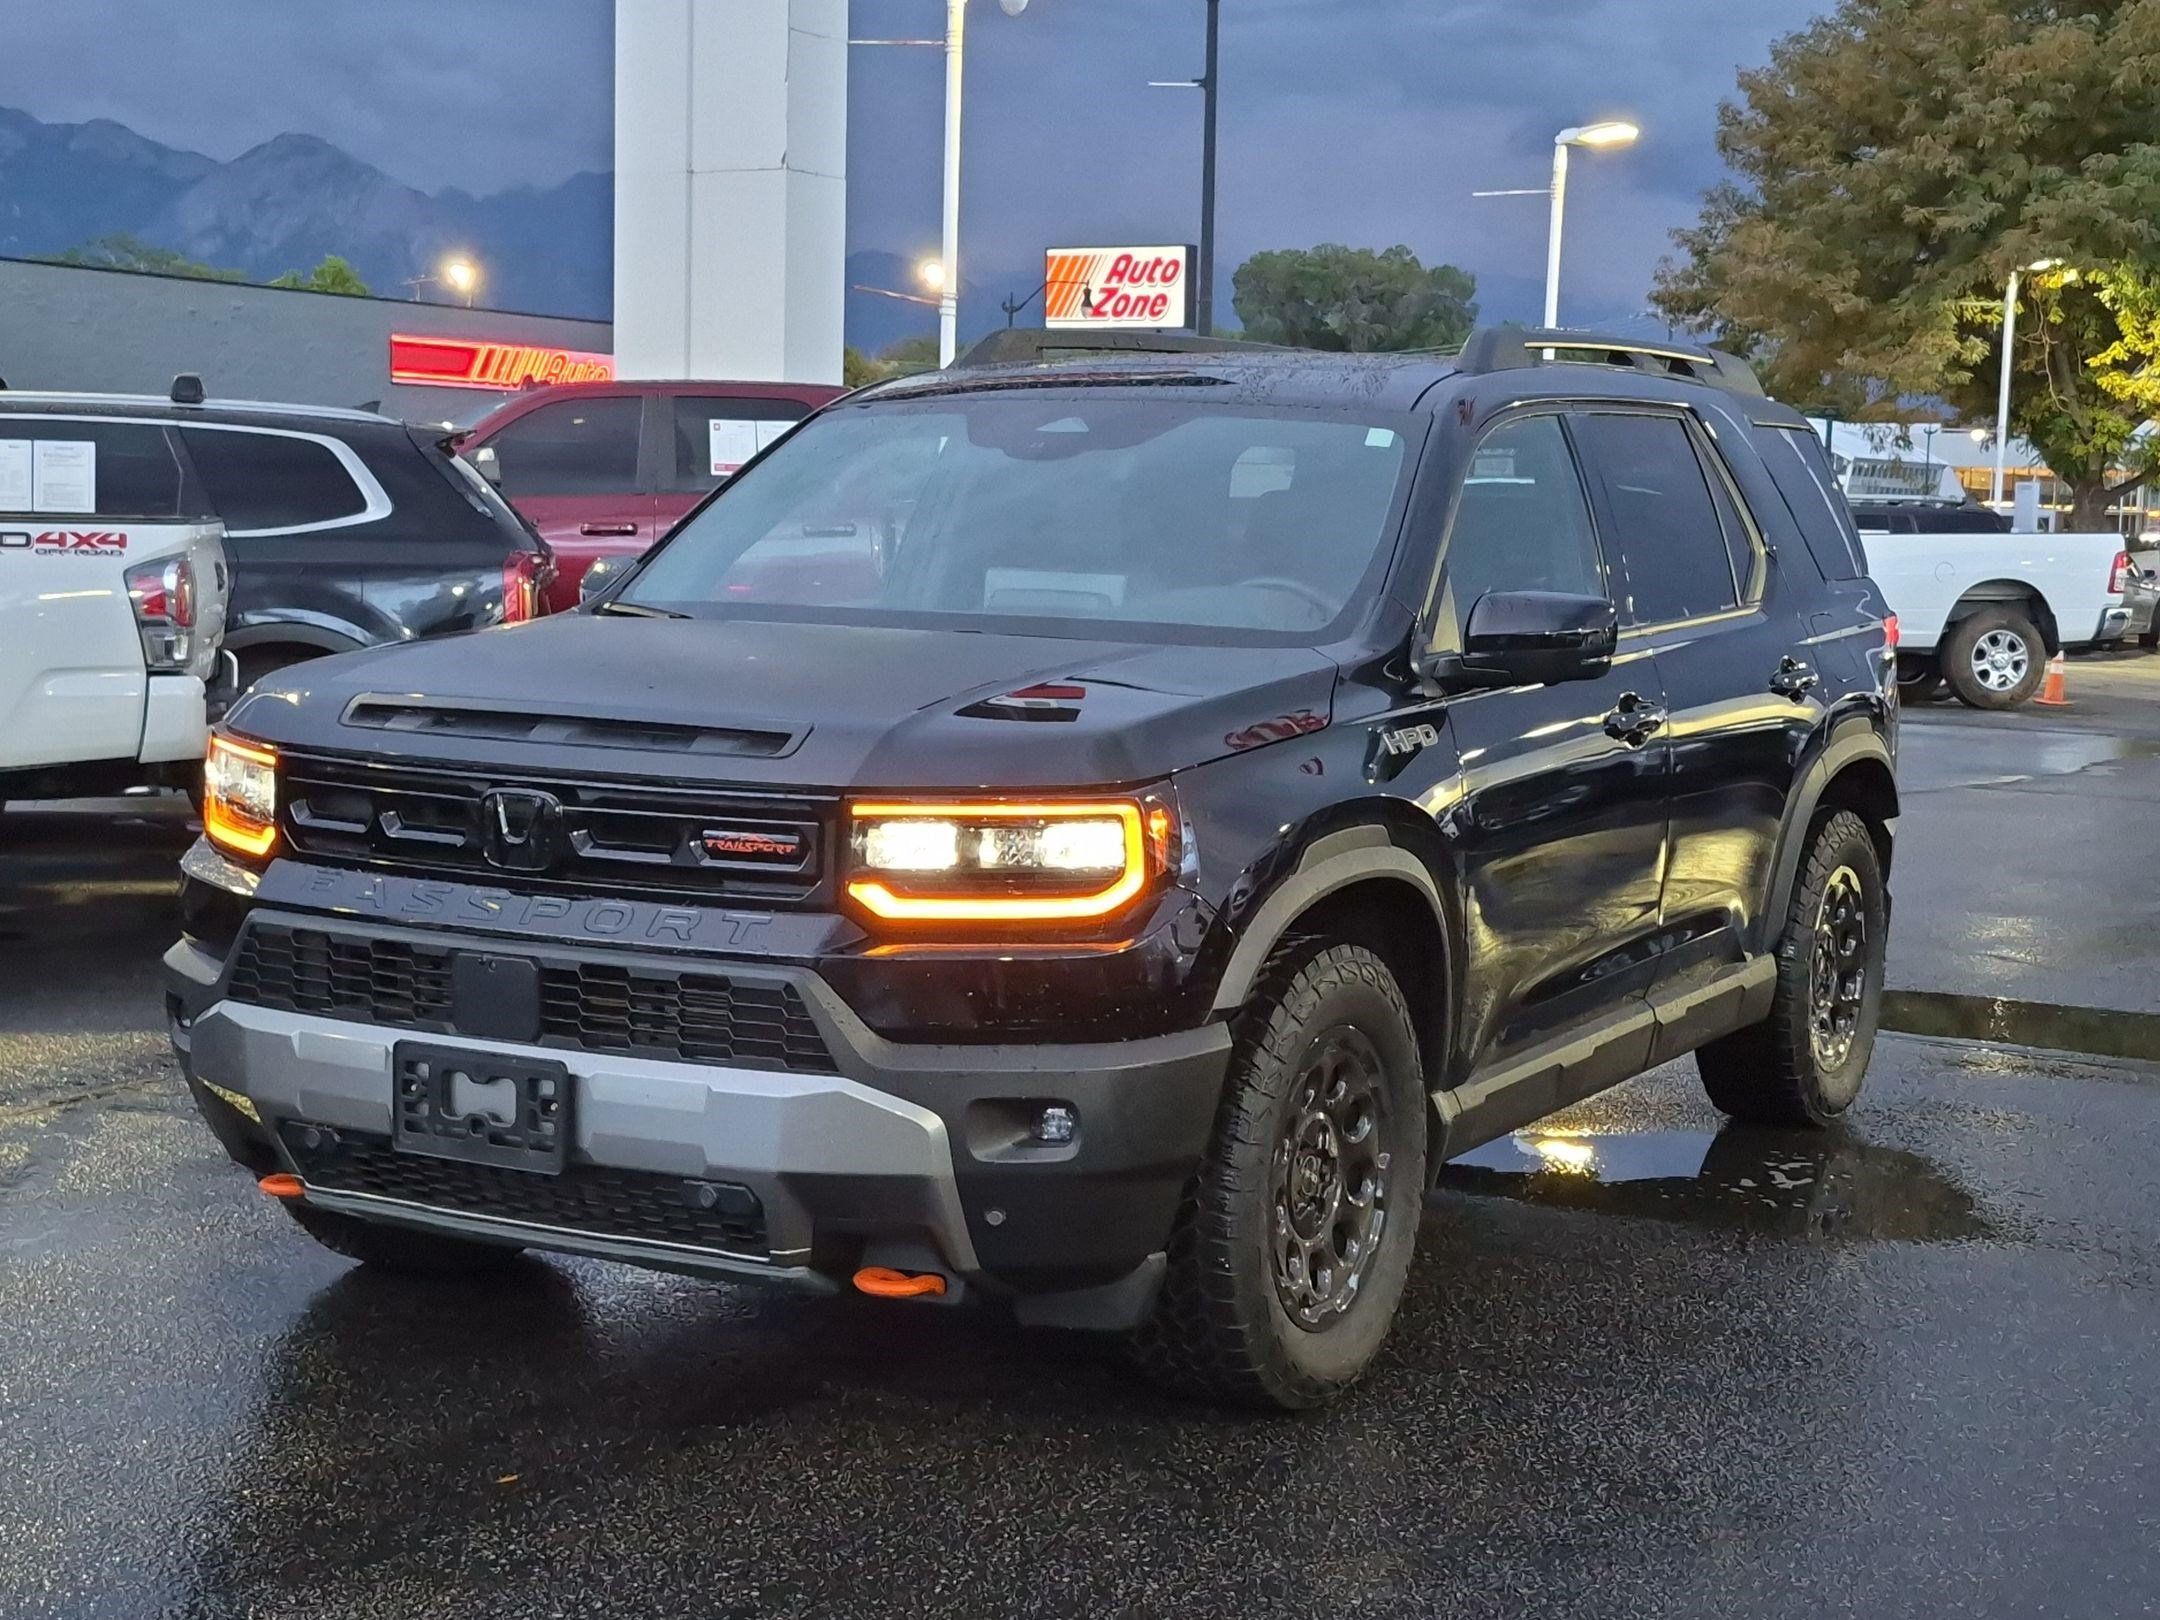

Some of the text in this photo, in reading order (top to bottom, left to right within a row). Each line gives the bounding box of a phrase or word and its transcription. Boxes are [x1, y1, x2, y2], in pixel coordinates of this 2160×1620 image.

[1104, 253, 1180, 285] Auto
[1089, 287, 1168, 318] Zone
[35, 548, 124, 557] OFF ROAD
[1383, 724, 1439, 755] HPD
[704, 838, 796, 855] TRAILSPORT
[309, 868, 774, 945] PASSPORT
